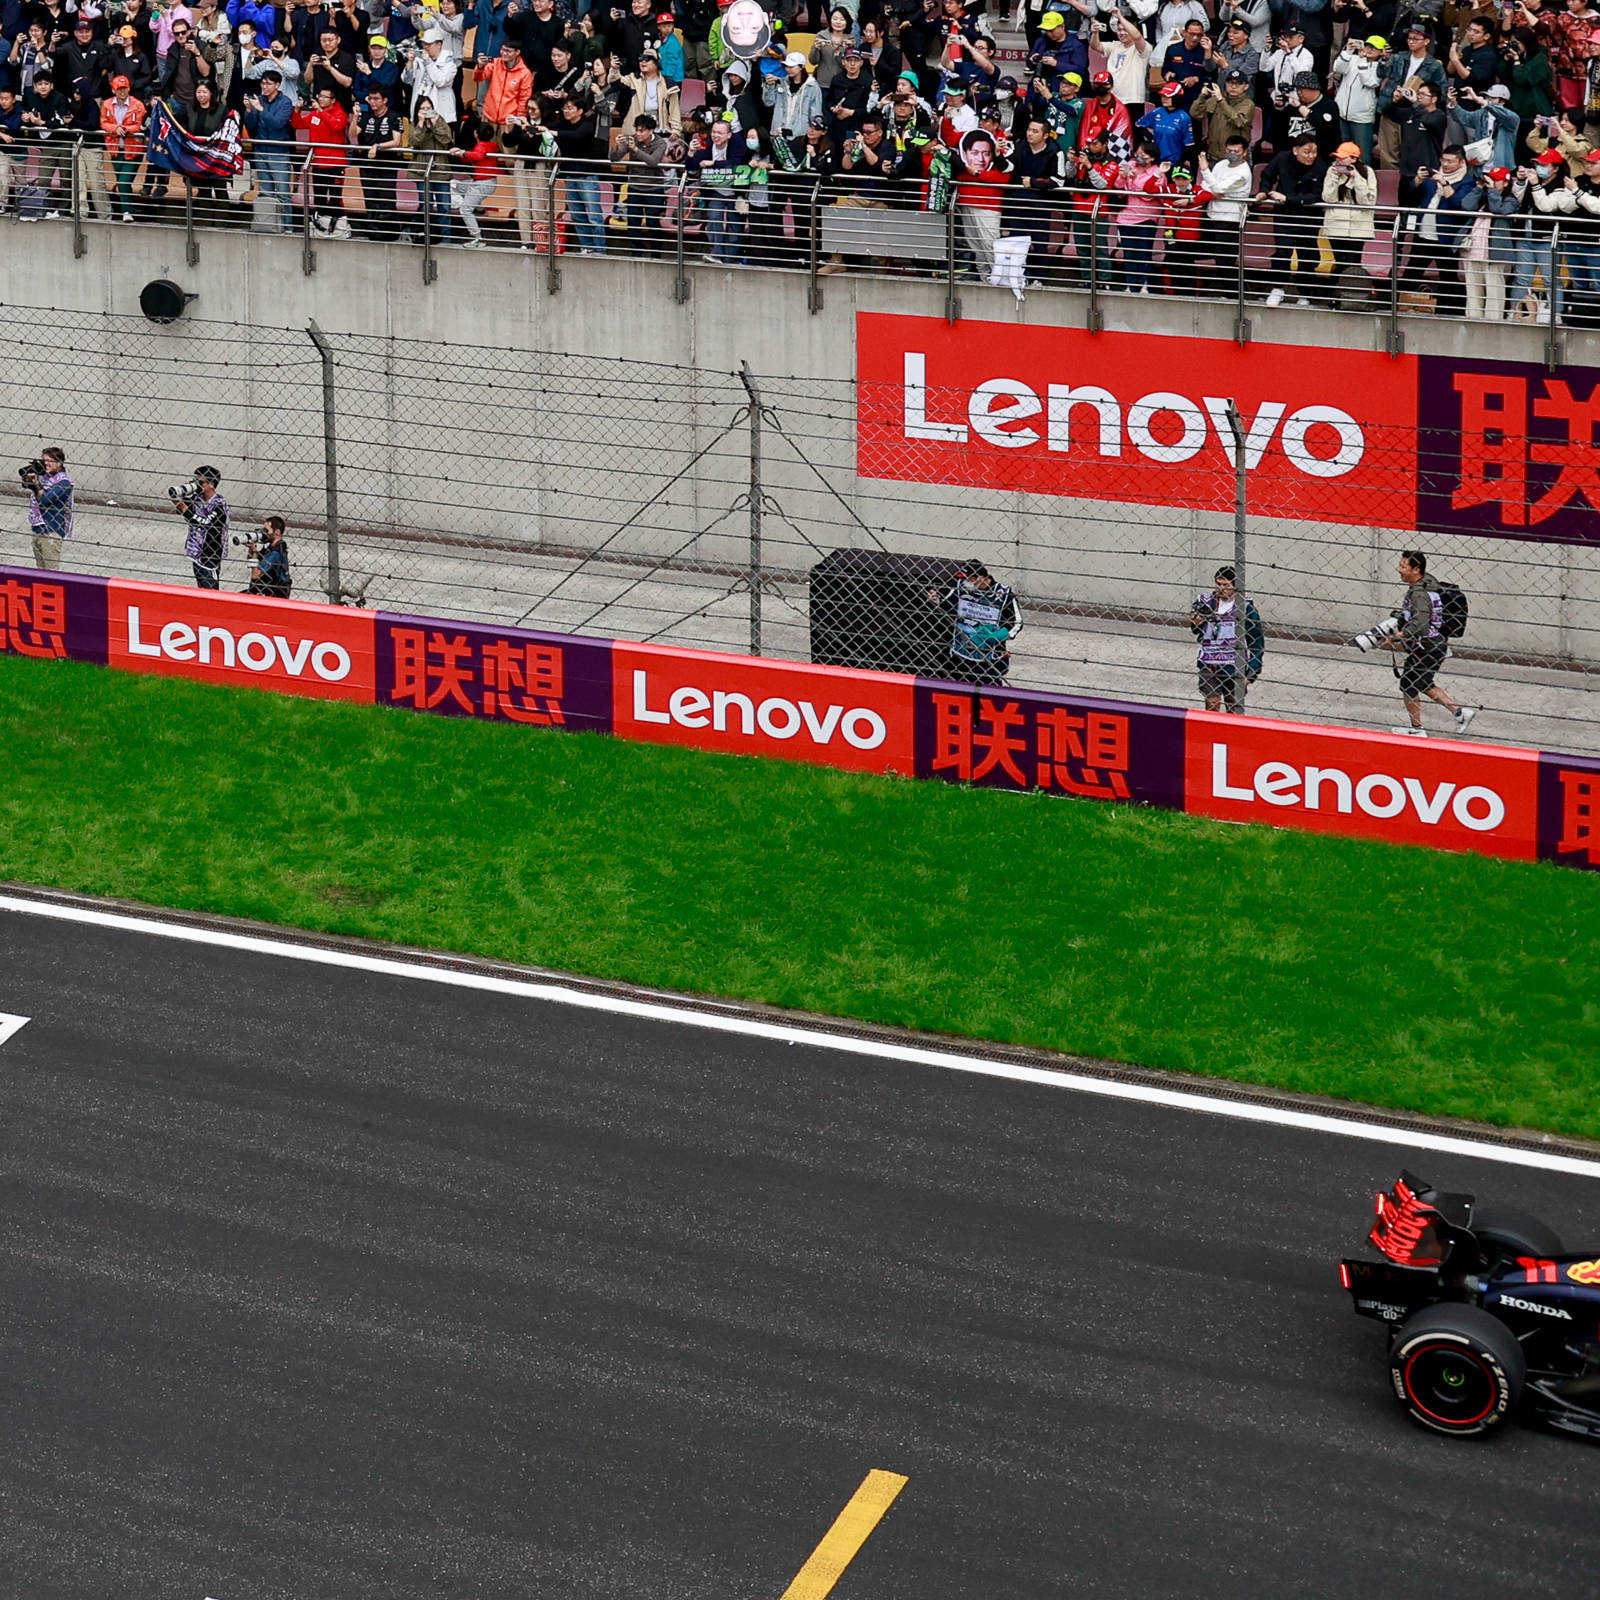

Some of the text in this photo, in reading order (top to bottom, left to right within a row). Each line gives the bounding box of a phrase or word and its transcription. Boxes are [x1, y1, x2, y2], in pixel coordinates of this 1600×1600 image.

[903, 350, 1366, 478] Lenovo
[127, 605, 352, 682] Lenovo
[390, 626, 565, 726] 联想
[632, 669, 887, 750] Lenovo
[931, 691, 1131, 800] 联想
[1211, 742, 1505, 832] Lenovo
[1500, 1294, 1572, 1320] HONDA
[1516, 1257, 1558, 1283] 11
[1492, 1365, 1509, 1412] ZERO
